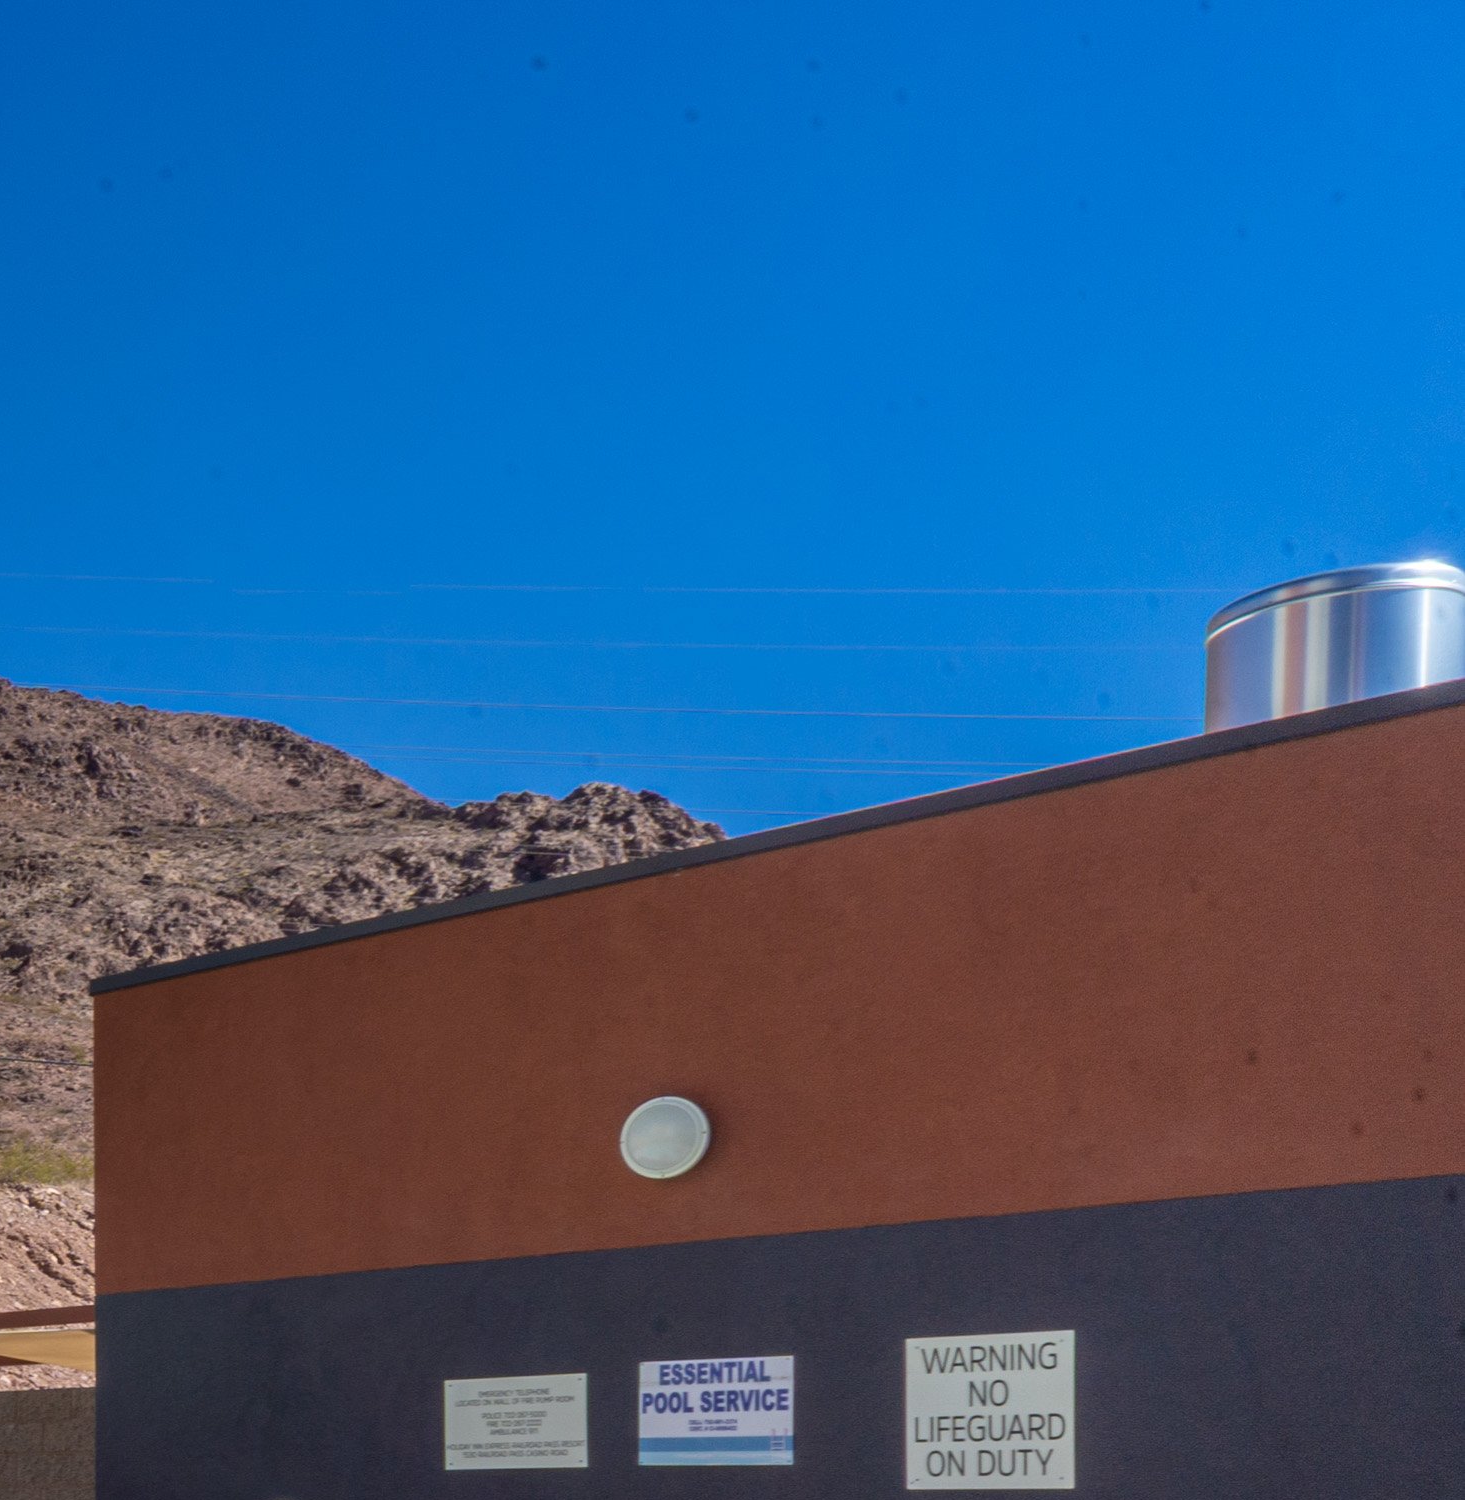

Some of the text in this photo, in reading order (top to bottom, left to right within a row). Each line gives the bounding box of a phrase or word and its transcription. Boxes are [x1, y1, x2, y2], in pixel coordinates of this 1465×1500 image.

[921, 1342, 1057, 1374] WARNING
[659, 1361, 771, 1386] ESSENTIAL
[642, 1388, 789, 1414] POOL SERVICE
[969, 1379, 1009, 1407] NO
[915, 1413, 1066, 1443] LIFEGUARD
[926, 1448, 1054, 1477] ON DUTY
